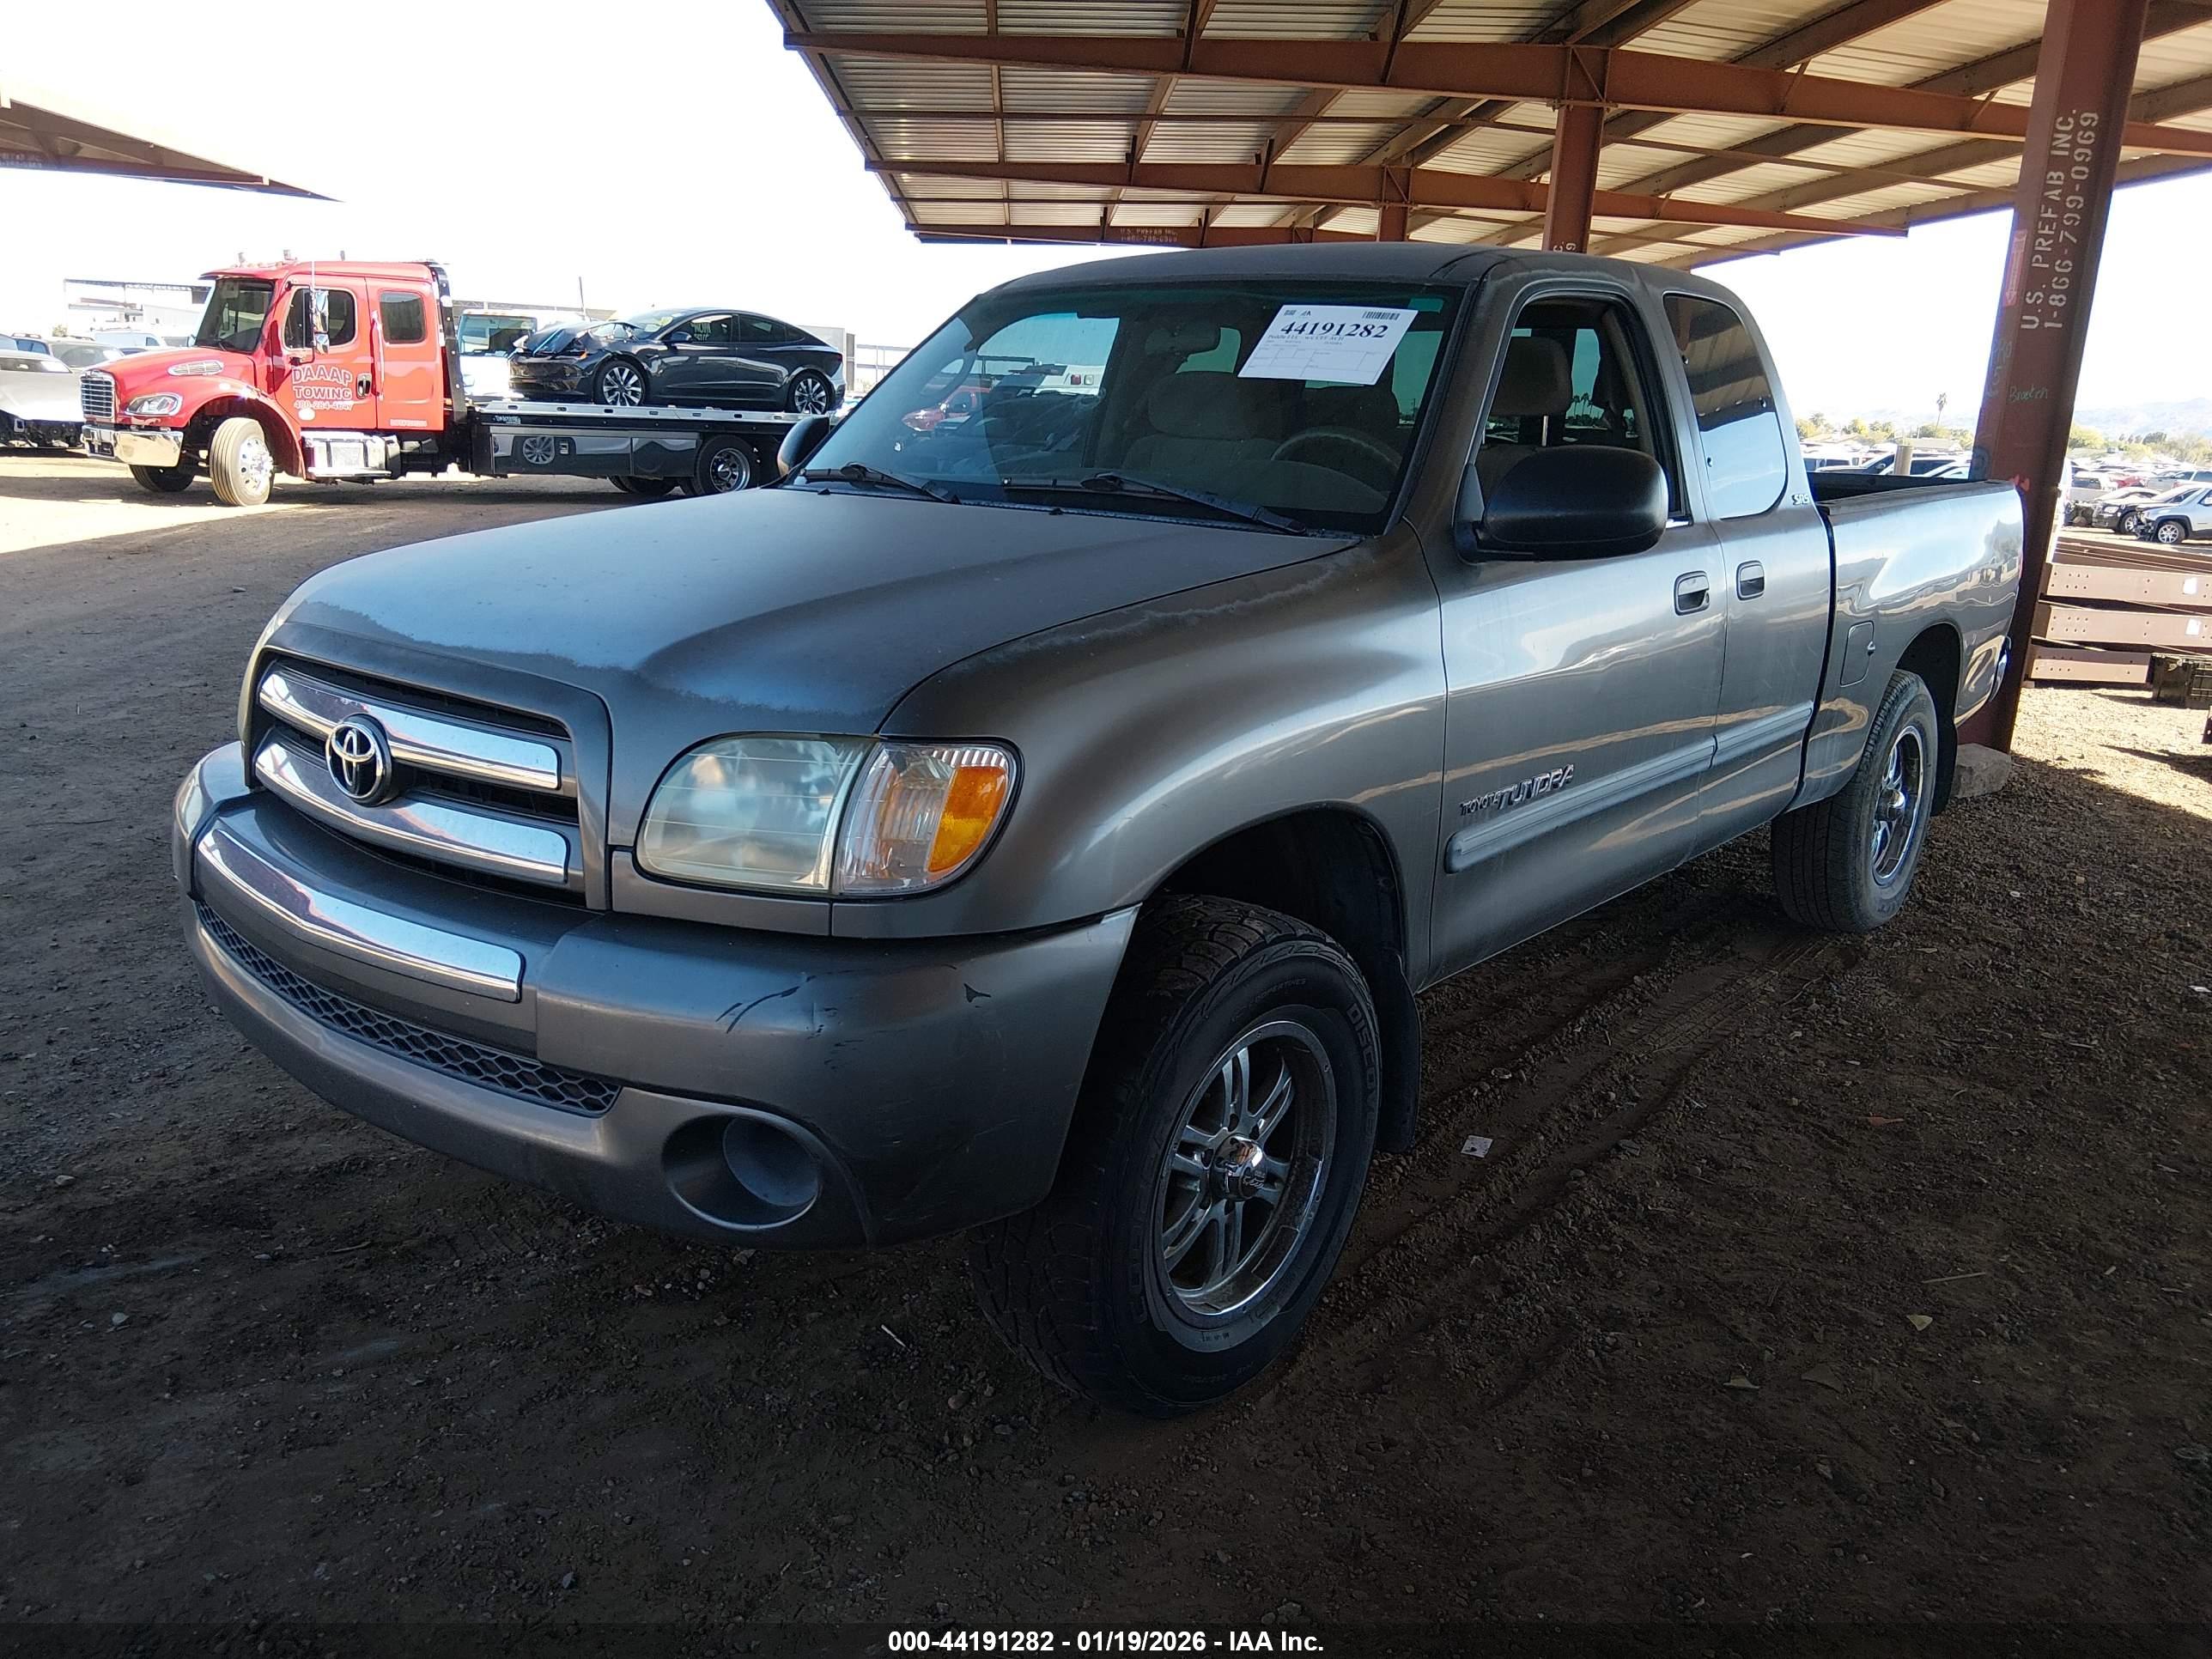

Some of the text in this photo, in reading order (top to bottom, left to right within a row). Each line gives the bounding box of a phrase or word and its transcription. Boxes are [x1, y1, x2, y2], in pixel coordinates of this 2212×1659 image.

[2021, 109, 2076, 329] U.S. PREFAB INC.
[2044, 112, 2099, 328] 1-866-799-0969
[1281, 321, 1389, 338] 44191282
[293, 365, 352, 386] DAAAP
[295, 386, 352, 399] TOWING
[1498, 763, 1574, 810] TUNDRA
